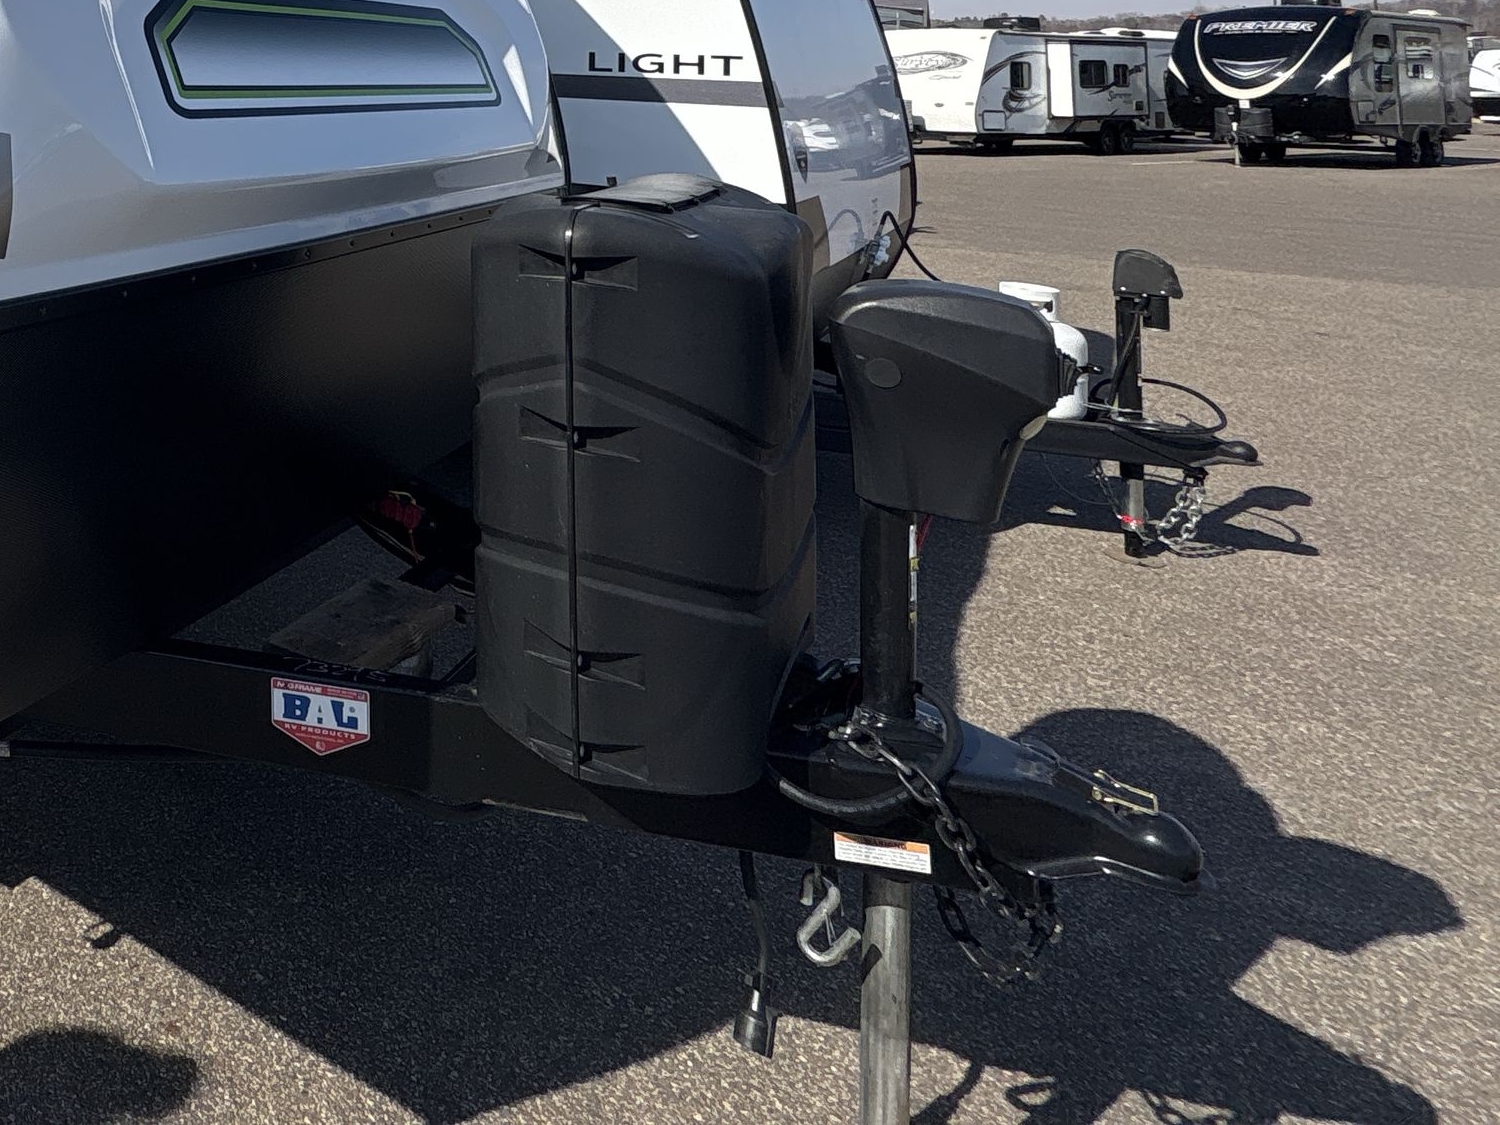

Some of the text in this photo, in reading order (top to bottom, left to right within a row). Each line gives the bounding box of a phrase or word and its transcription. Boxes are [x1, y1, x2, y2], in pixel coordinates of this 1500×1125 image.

[1203, 20, 1318, 34] PREMIER
[588, 51, 744, 76] LIGHT
[282, 692, 359, 730] BAL
[284, 723, 299, 731] RV
[301, 726, 356, 740] PRODUCTS
